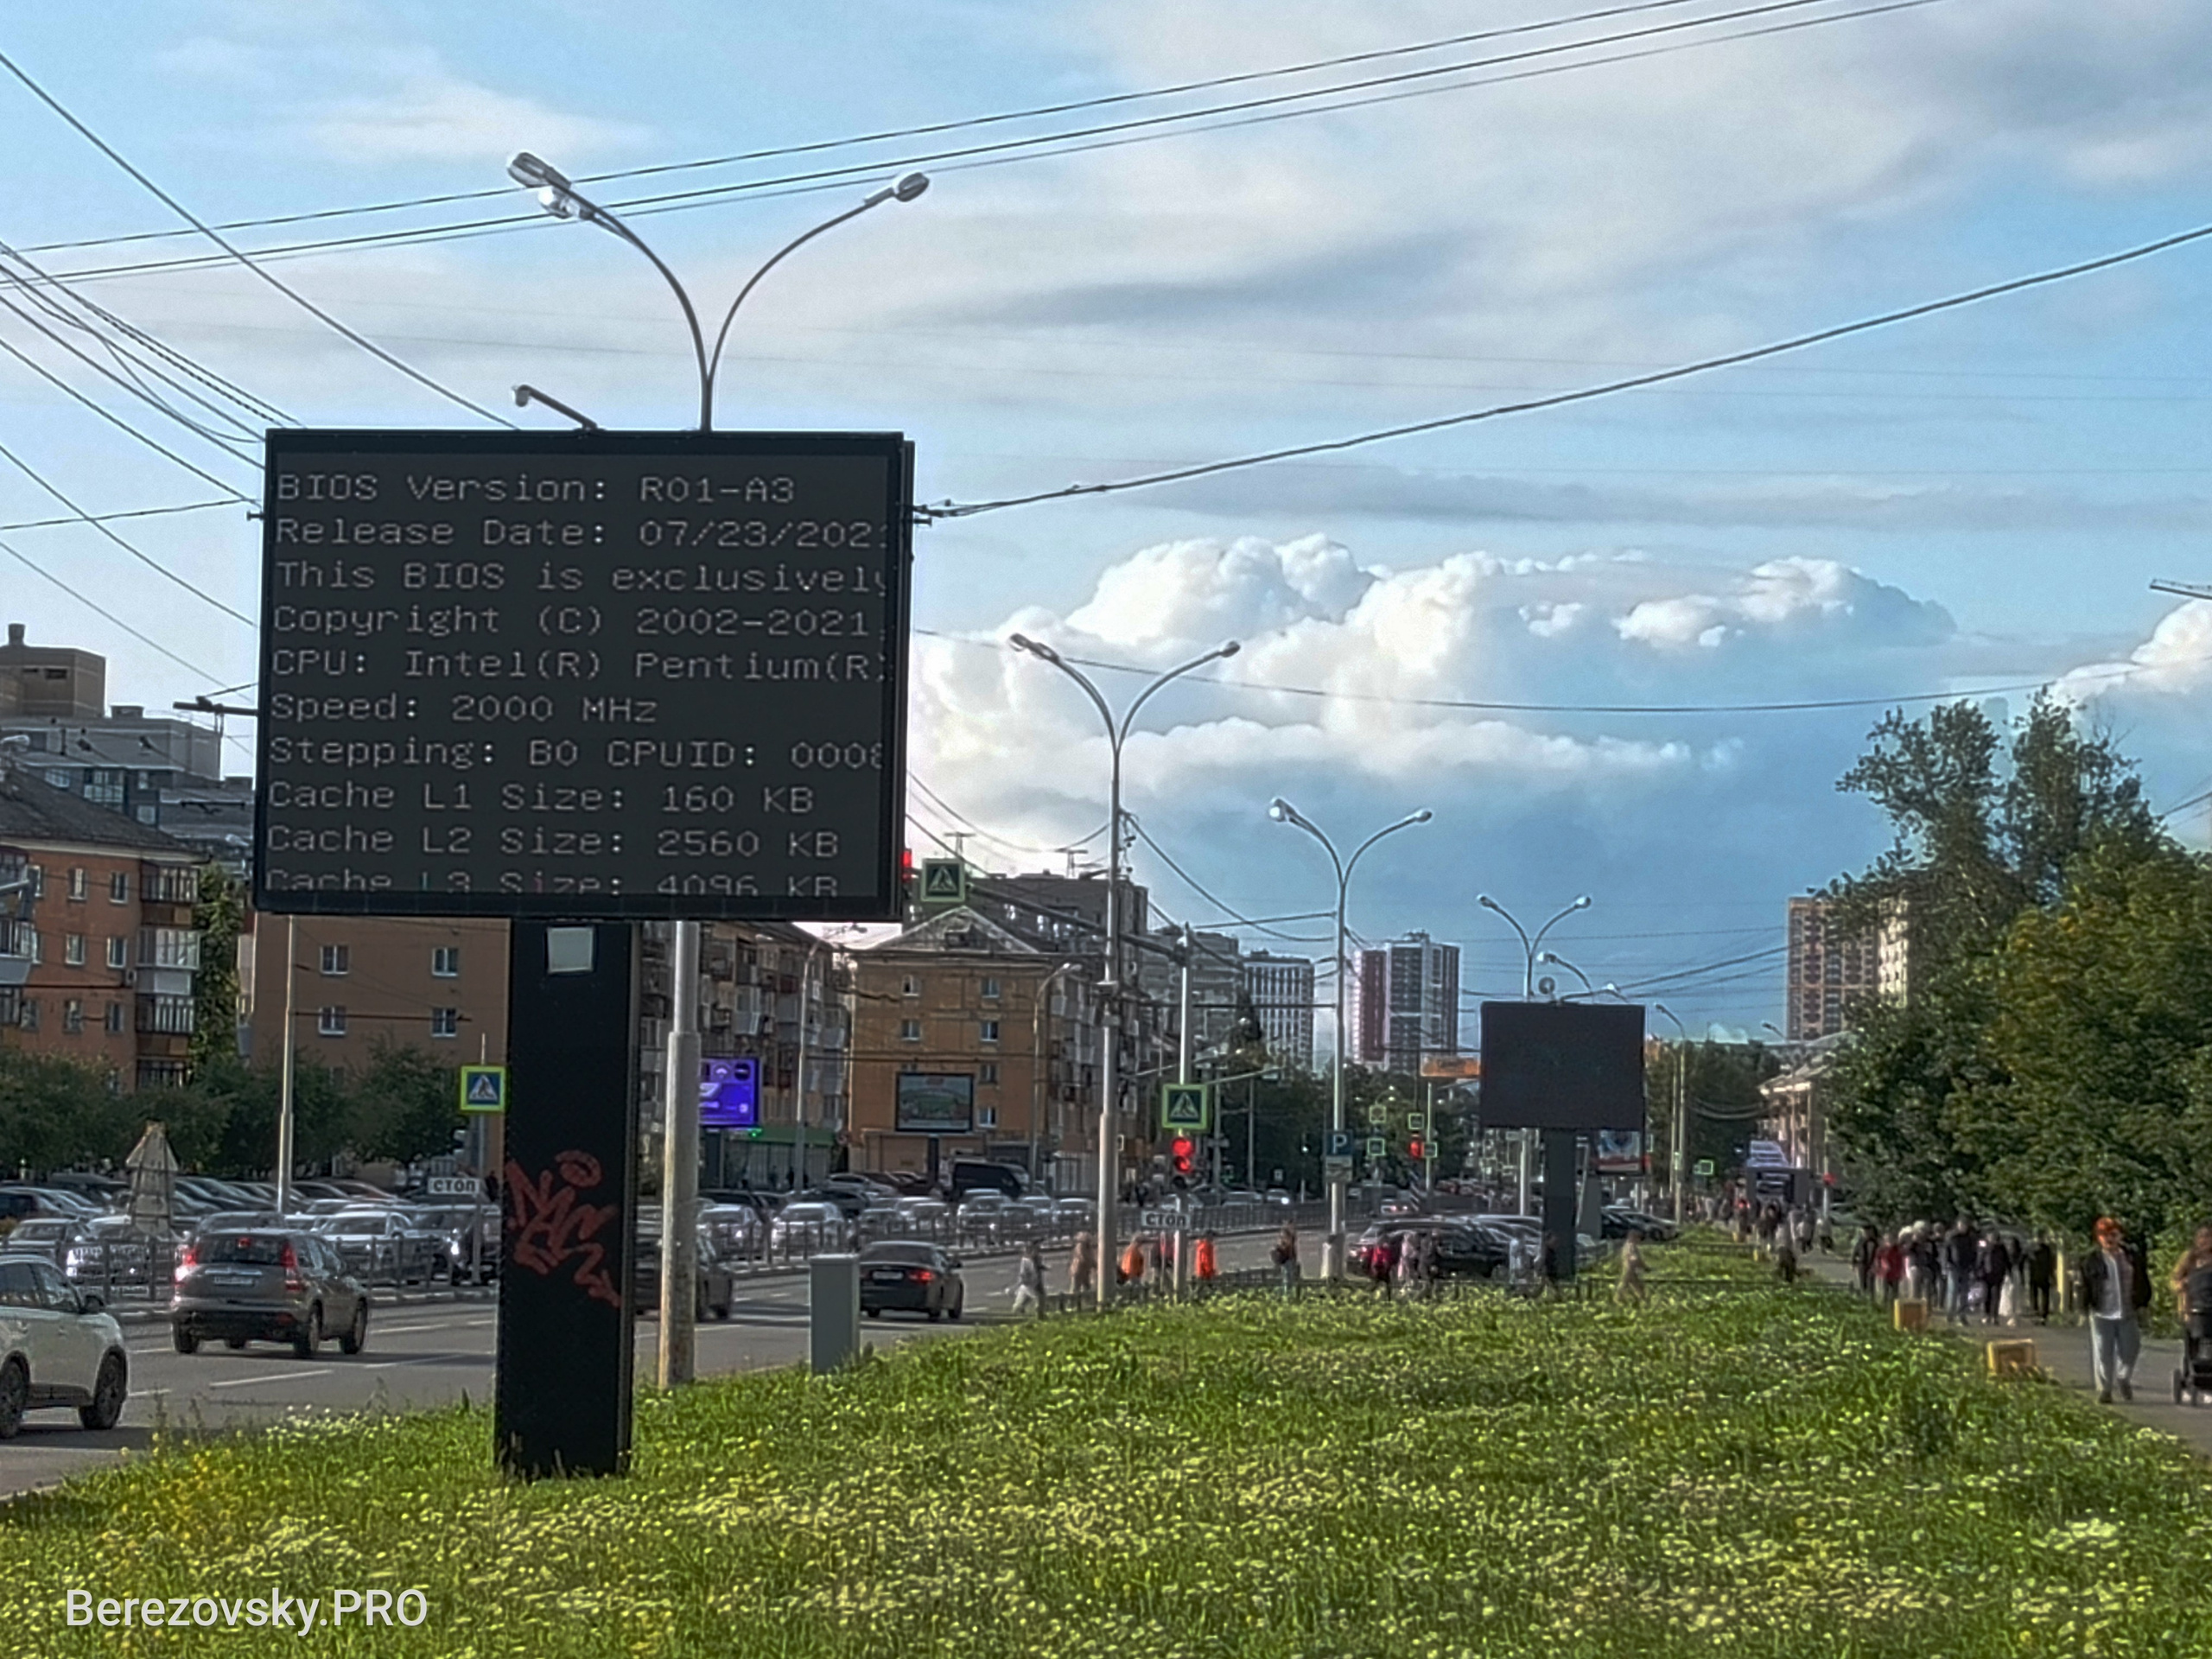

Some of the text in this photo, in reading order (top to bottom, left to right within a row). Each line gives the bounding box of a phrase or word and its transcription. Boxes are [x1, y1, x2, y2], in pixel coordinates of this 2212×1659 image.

[277, 473, 794, 503] BIOS Version: R01-A3
[276, 518, 454, 544] Release
[483, 519, 604, 546] Date:
[276, 560, 375, 588] This
[404, 563, 505, 589] BIOS
[537, 561, 582, 590] is
[274, 604, 499, 637] Copyright
[539, 605, 601, 636] (C)
[272, 649, 365, 676] CPU:
[405, 650, 600, 679] Intel(R)
[270, 692, 658, 723] Speed: 2000 MHz
[269, 736, 493, 770] Stepping:
[530, 740, 578, 766] B0
[607, 741, 754, 767] CPUID:
[268, 780, 813, 813] Cache L1 Size: 160 KB
[266, 824, 838, 857] Cache L2 Size: 2560 KB
[433, 1179, 476, 1192] СТОП
[1145, 1212, 1187, 1227] СТОП
